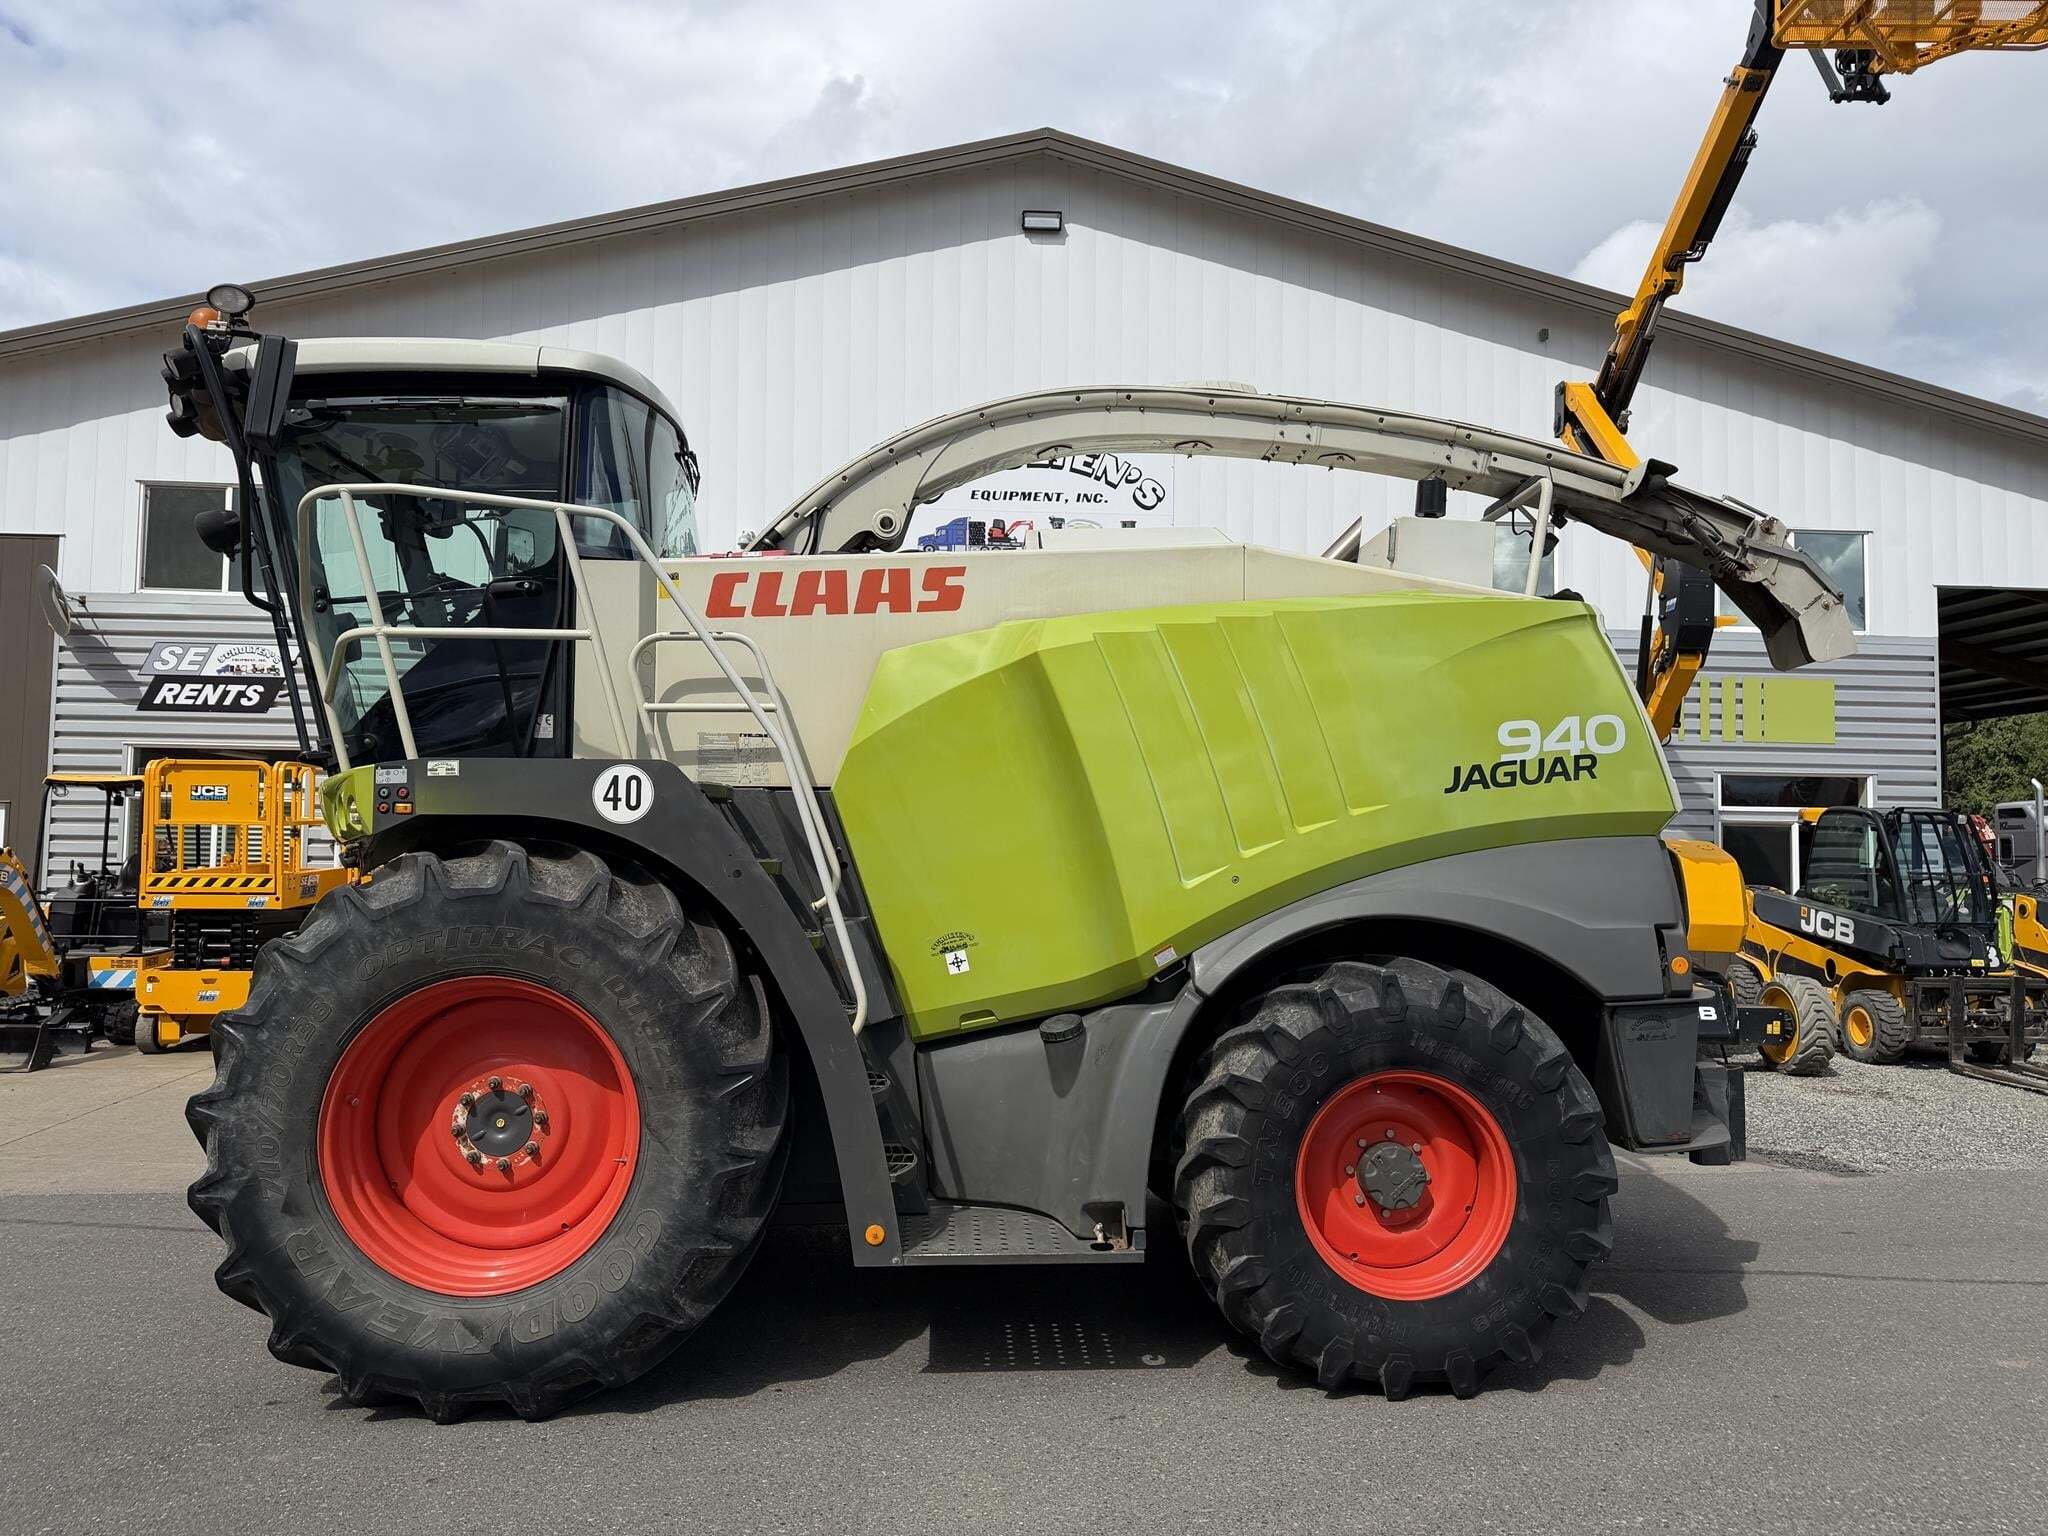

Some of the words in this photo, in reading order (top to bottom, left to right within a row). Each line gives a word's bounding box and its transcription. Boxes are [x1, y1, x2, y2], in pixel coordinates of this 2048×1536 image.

[970, 489, 1069, 505] EQUIPMENT,
[1075, 492, 1109, 504] INC.
[705, 566, 968, 619] CLAAS
[152, 645, 211, 672] SE
[153, 683, 265, 706] RENTS
[1497, 714, 1626, 763] 940
[191, 785, 227, 796] JCB
[602, 774, 642, 811] 40
[1444, 753, 1598, 794] JAGUAR
[1800, 907, 1855, 944] JCB
[353, 925, 591, 981] OPTITRAC
[254, 999, 333, 1200] 710/70R38
[285, 1208, 662, 1355] GOODYEAR
